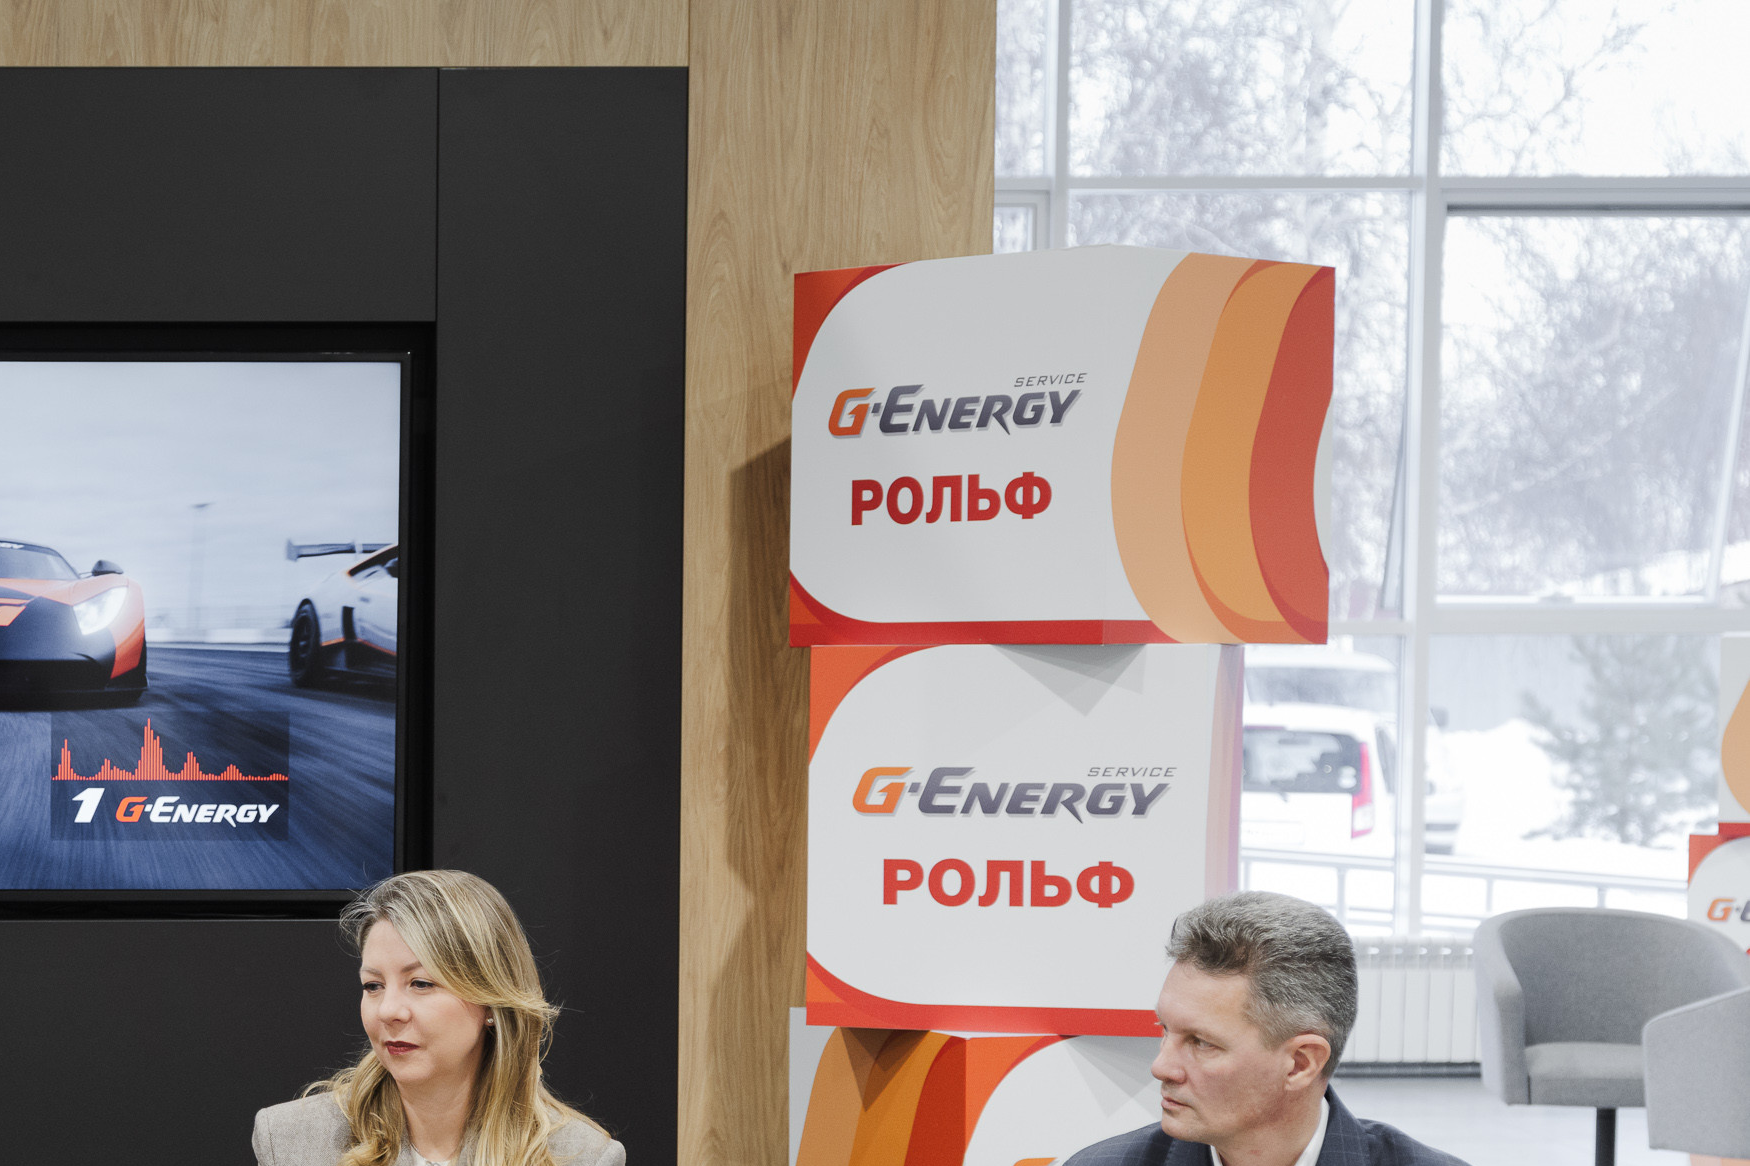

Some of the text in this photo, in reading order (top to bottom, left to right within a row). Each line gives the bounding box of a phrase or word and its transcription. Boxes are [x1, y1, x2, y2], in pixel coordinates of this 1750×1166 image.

[1014, 372, 1088, 388] SERVICE
[851, 471, 1052, 526] РОЛЬФ
[1087, 766, 1178, 778] SERVICE
[883, 858, 1135, 909] РОЛЬФ
